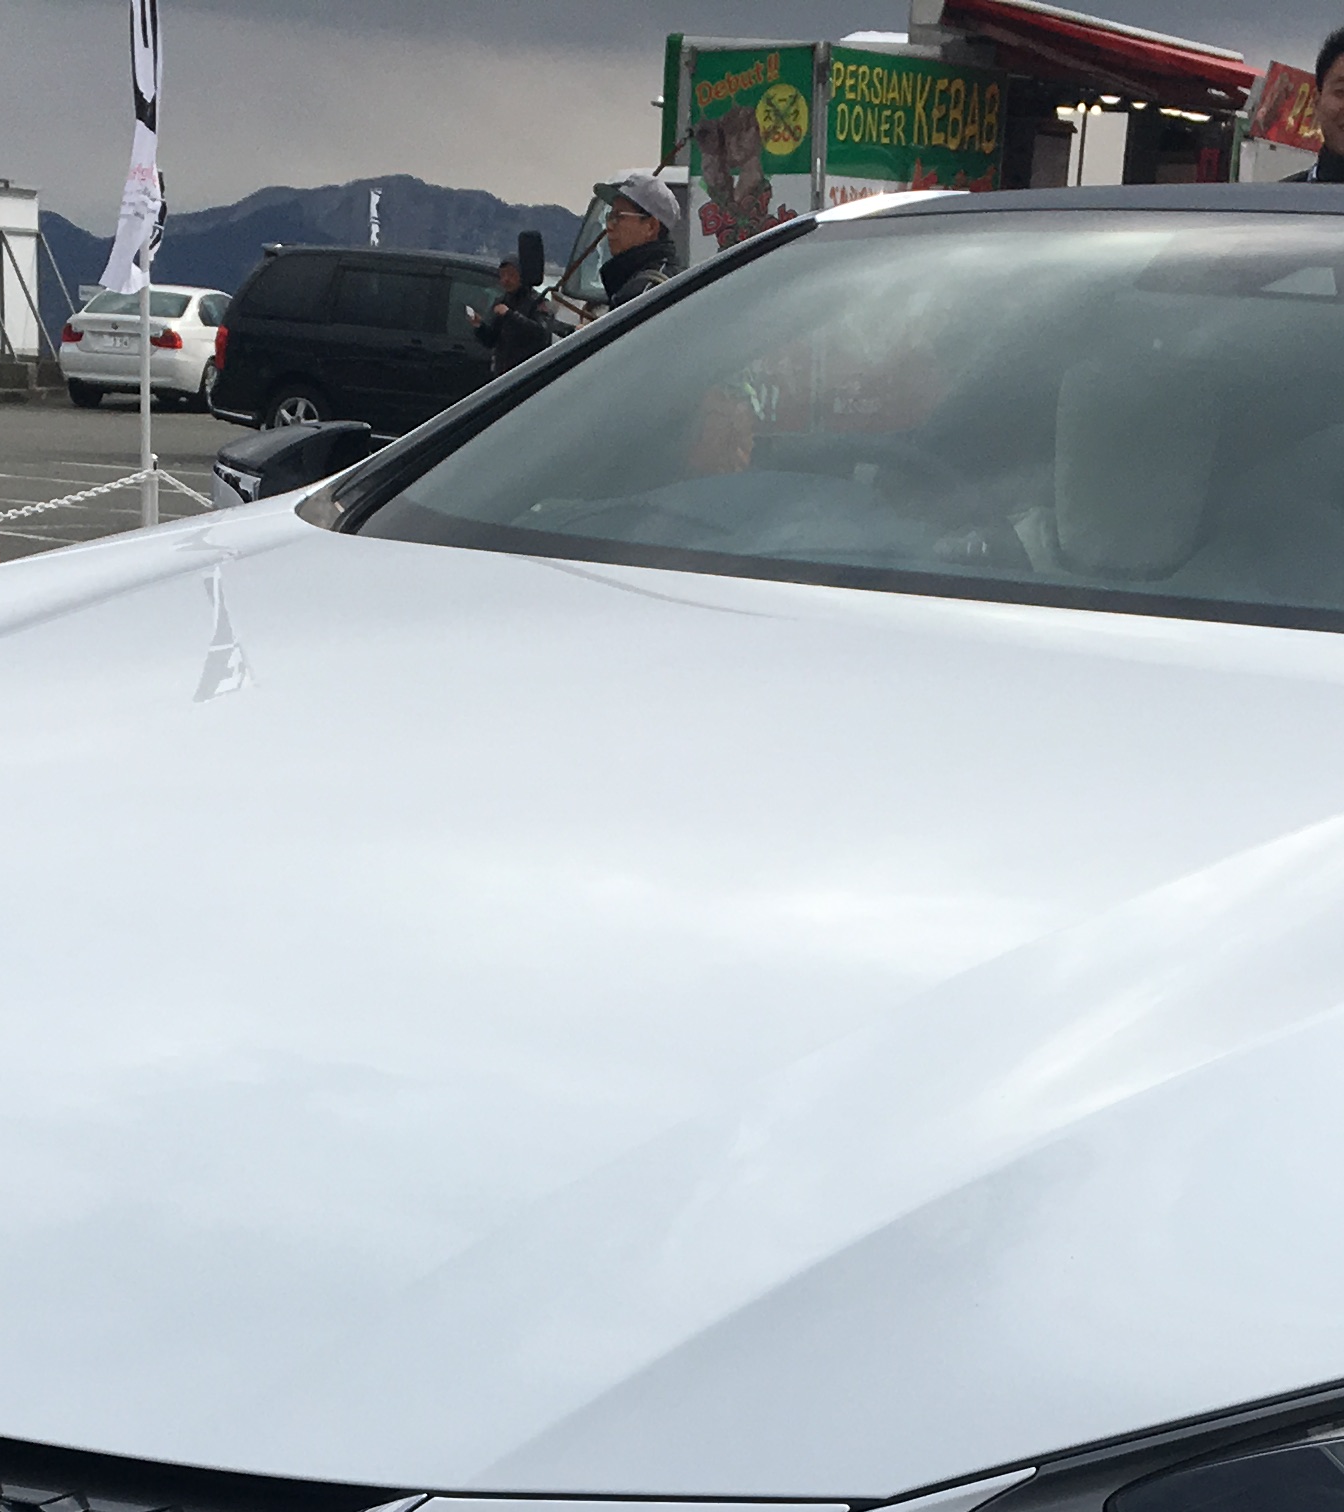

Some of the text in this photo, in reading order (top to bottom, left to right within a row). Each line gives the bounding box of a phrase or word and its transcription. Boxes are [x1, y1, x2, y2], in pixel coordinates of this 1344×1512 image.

[831, 60, 914, 107] PERSIAN
[836, 102, 907, 146] DONER
[912, 72, 1000, 154] KEBAB
